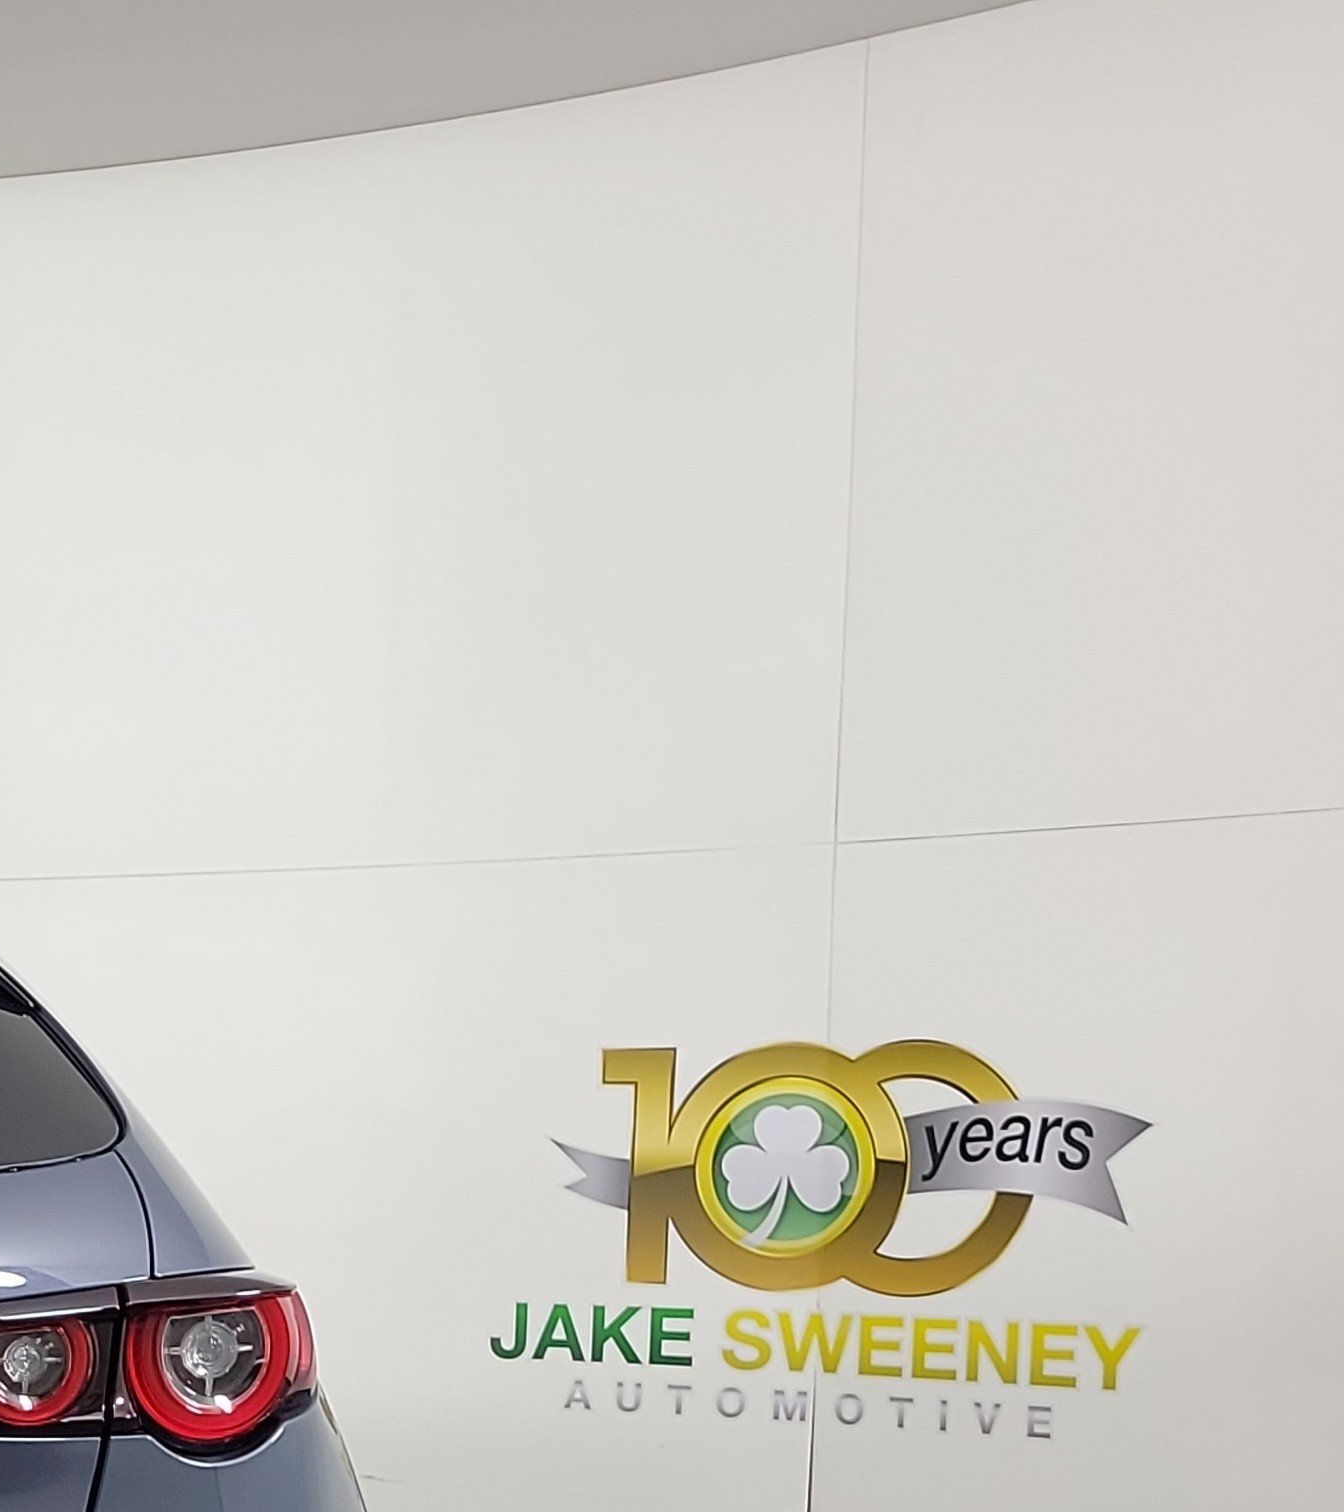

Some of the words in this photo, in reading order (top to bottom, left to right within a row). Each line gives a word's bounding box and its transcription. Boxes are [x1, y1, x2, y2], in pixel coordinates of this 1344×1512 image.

[600, 1038, 1035, 1298] 100
[919, 1112, 1095, 1181] years
[489, 1301, 696, 1368] JAKE
[720, 1308, 1141, 1391] SWEENEY
[563, 1379, 1052, 1439] AUTOMOTIVE
